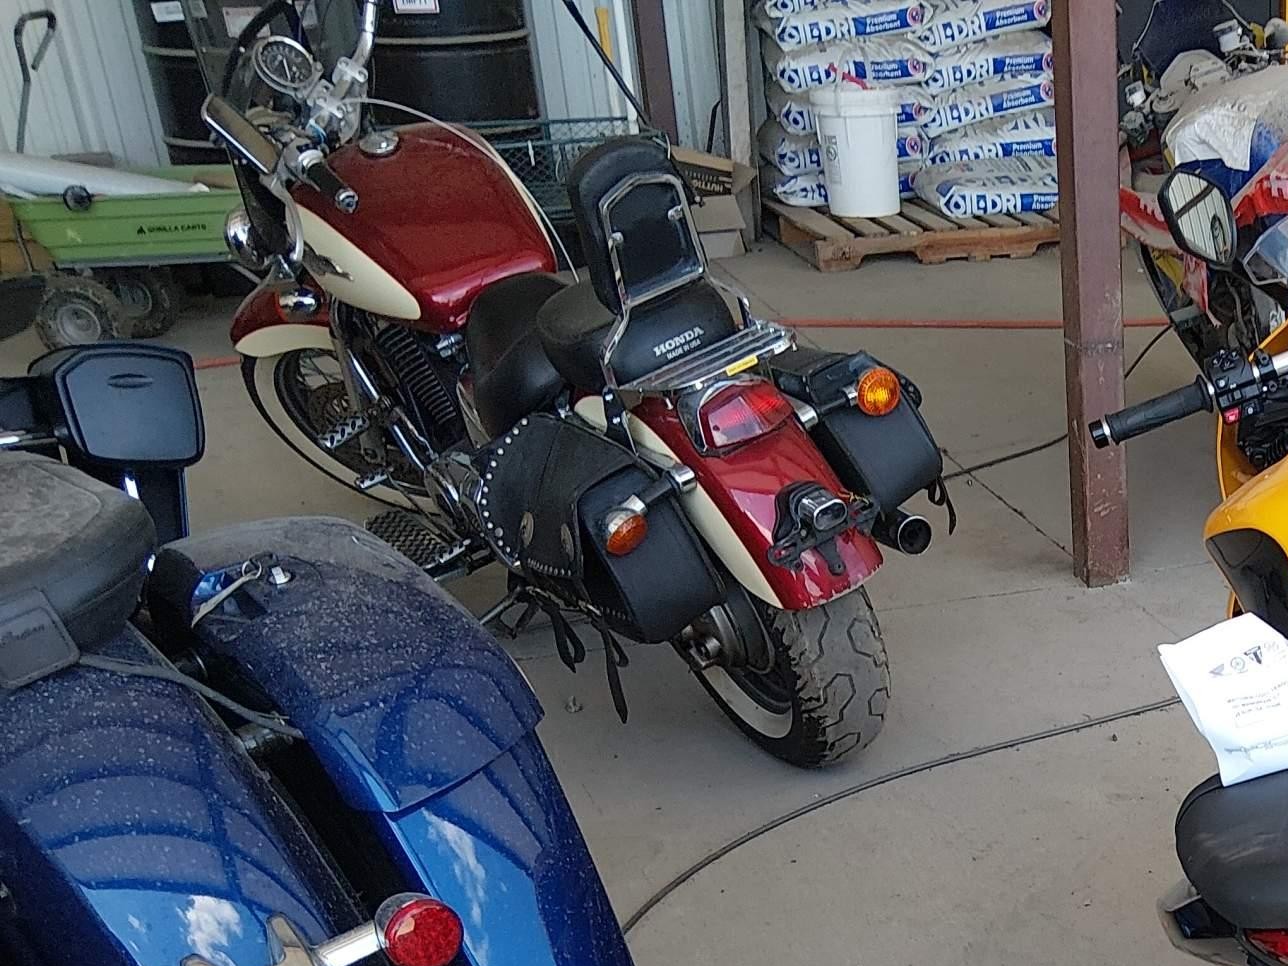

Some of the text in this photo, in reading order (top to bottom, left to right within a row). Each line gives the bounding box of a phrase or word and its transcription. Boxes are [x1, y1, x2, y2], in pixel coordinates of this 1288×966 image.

[866, 13, 898, 24] Premium
[996, 7, 1025, 18] Premium
[995, 13, 1028, 27] Absorbent
[866, 20, 901, 33] Absorbent
[1005, 56, 1034, 66] Premium
[1003, 97, 1036, 109] Absorbent
[1012, 142, 1043, 151] Premium
[652, 326, 705, 357] HONDA
[666, 348, 684, 361] MADE
[690, 339, 702, 351] USA
